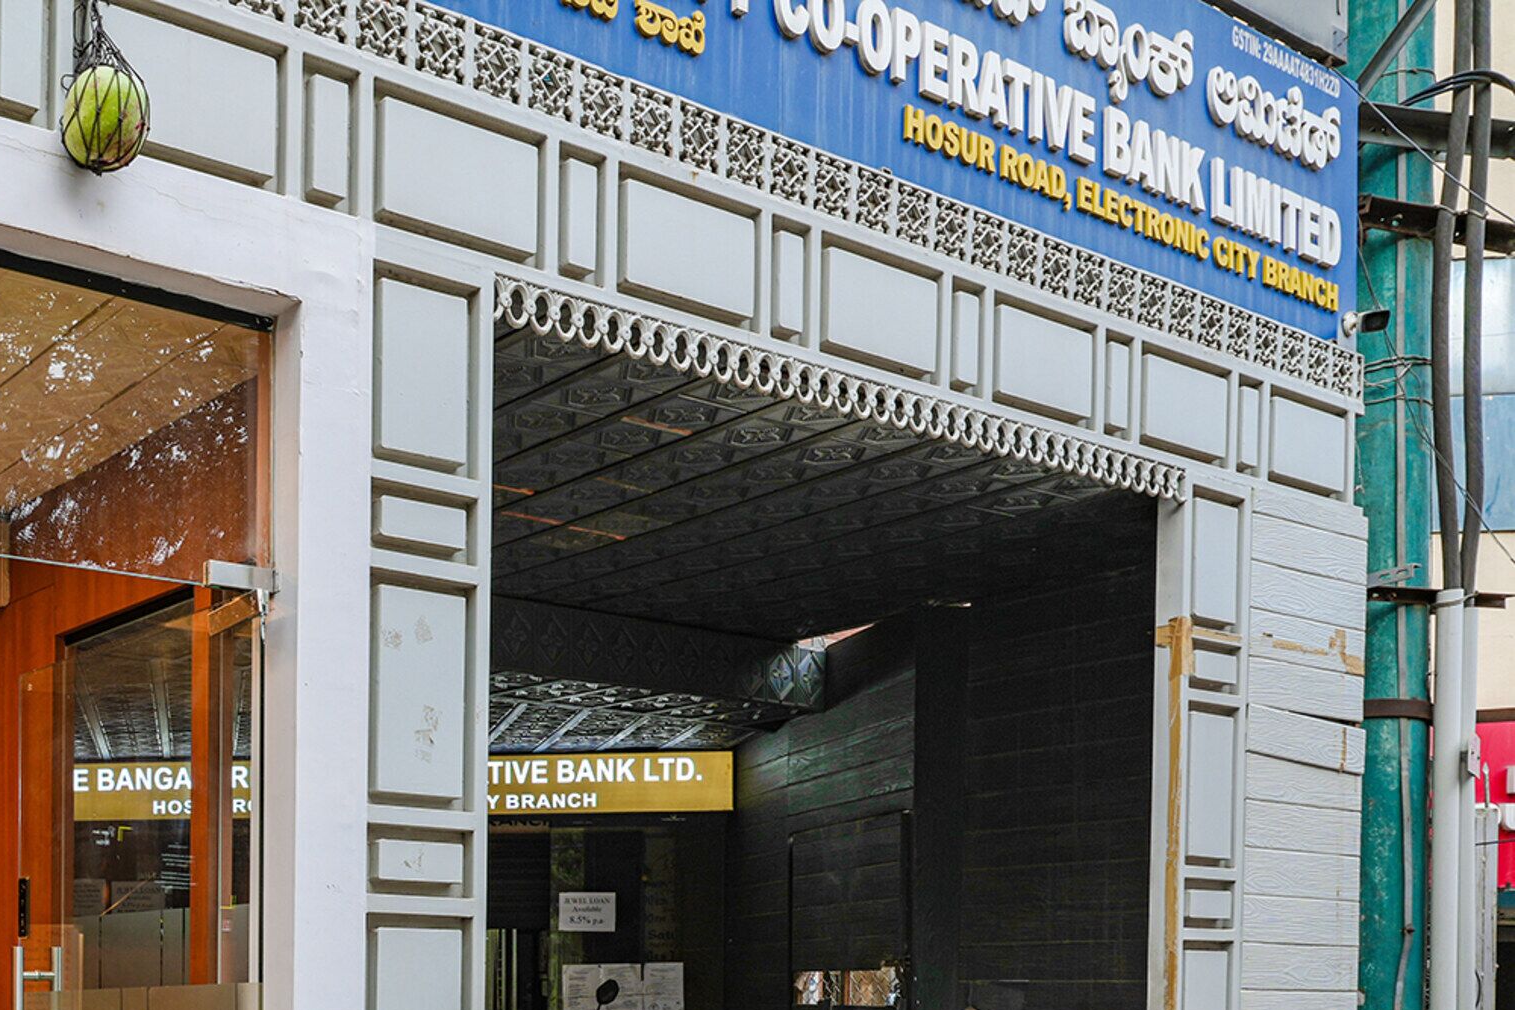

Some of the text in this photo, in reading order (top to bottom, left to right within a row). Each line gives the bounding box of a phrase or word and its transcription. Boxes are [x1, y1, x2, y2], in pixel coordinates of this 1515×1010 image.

[1232, 25, 1261, 60] GSTIN:
[1103, 104, 1206, 215] BANK
[1210, 156, 1342, 269] LIMITED
[903, 104, 1340, 312] HOSUR ROAD, ELECTRONIC CITY BRANCH
[486, 757, 703, 785] TIVE BANK LTD.
[505, 793, 598, 810] BRANCH
